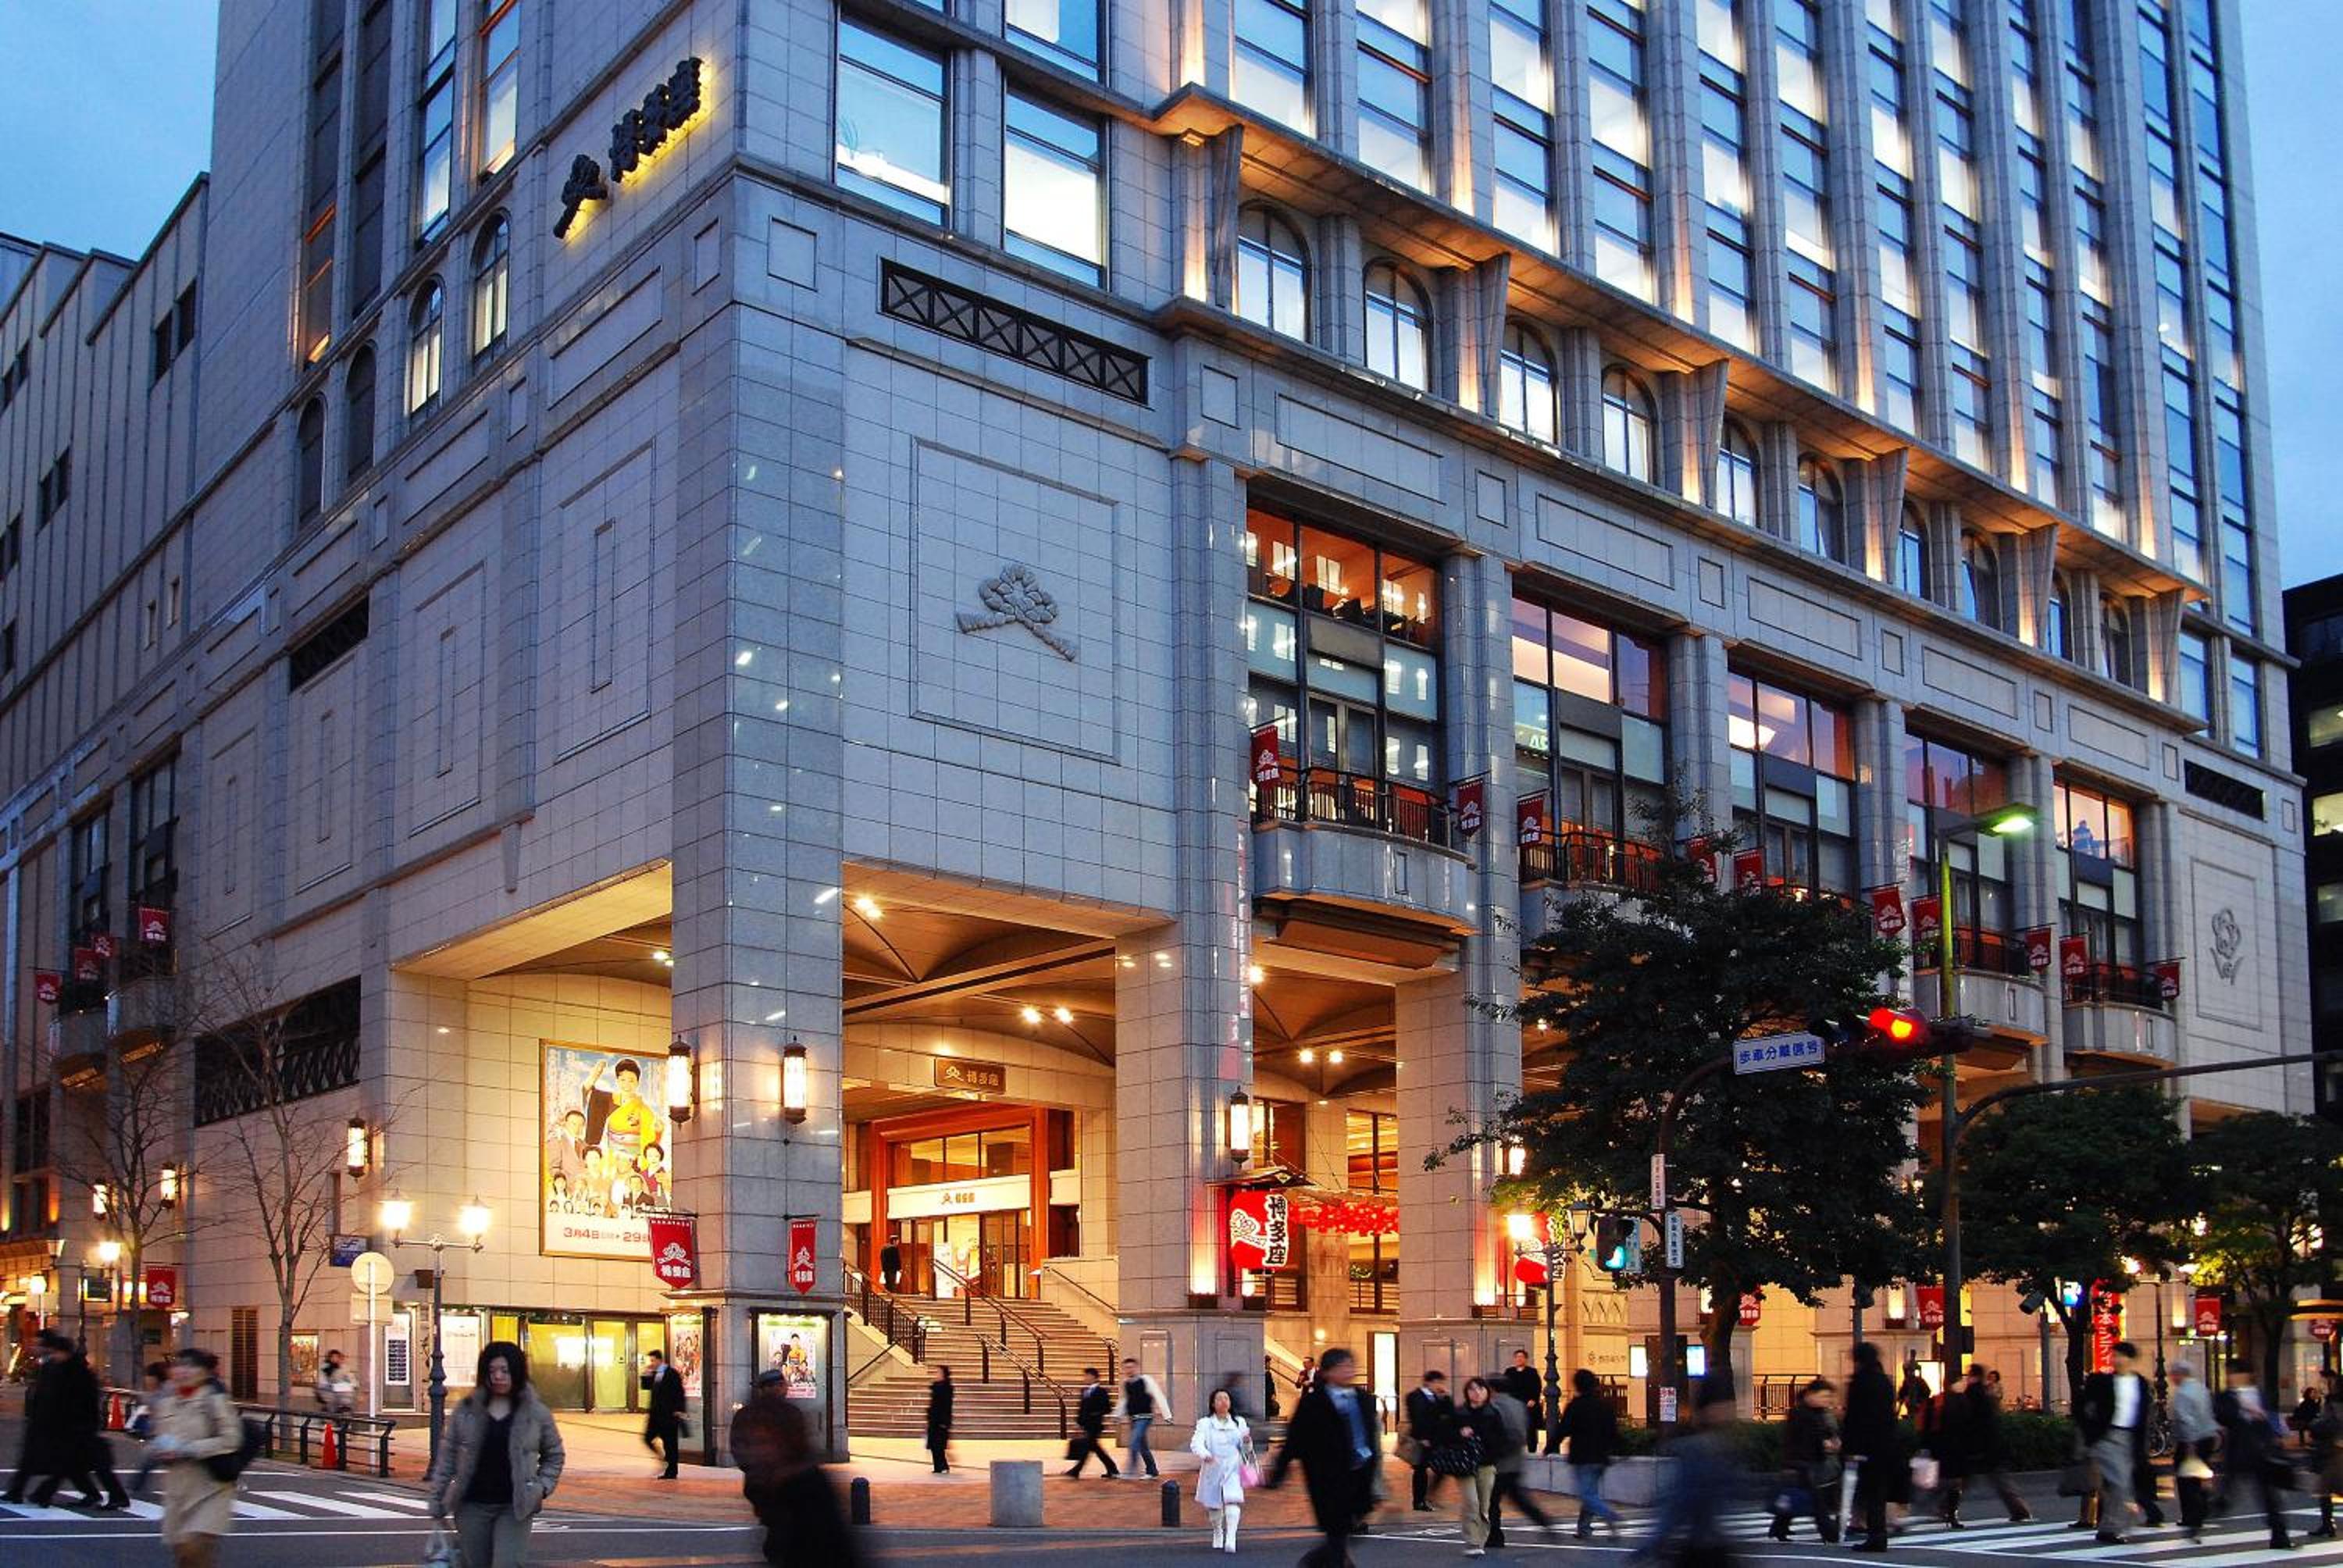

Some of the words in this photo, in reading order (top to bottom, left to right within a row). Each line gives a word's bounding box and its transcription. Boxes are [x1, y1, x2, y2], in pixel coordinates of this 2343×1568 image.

[1739, 1039, 1818, 1064] 歩車分離信号
[1265, 1196, 1286, 1264] 博多座
